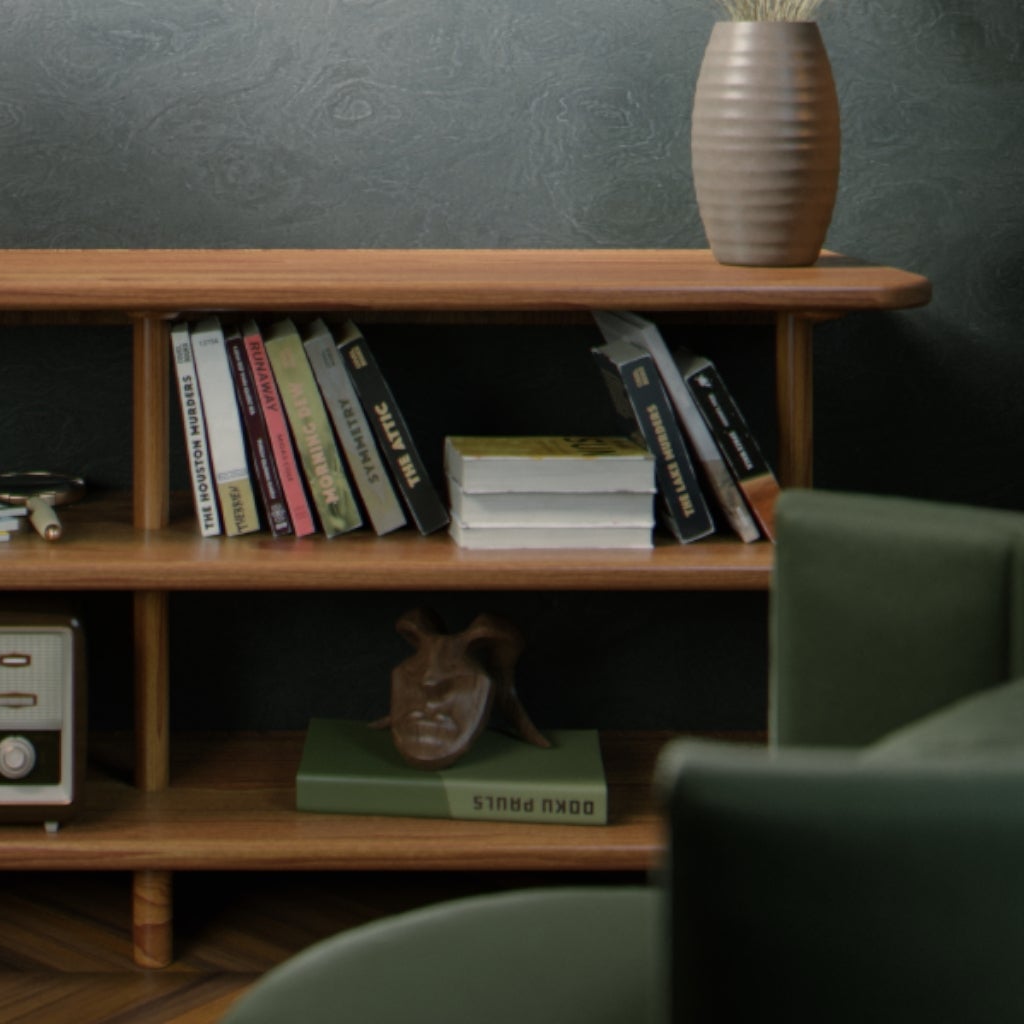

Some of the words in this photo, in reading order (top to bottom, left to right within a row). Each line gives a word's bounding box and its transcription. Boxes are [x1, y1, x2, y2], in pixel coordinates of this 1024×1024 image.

[250, 340, 278, 413] RUNAWAY
[182, 375, 200, 436] MURDERS
[372, 402, 408, 452] ATTIC
[301, 420, 340, 506] MORNING
[337, 396, 381, 485] SYMMETRY
[190, 439, 211, 503] HOUSTON
[396, 451, 422, 489] THE
[201, 506, 215, 531] THE
[676, 490, 696, 520] THE
[473, 795, 534, 813] PAULS
